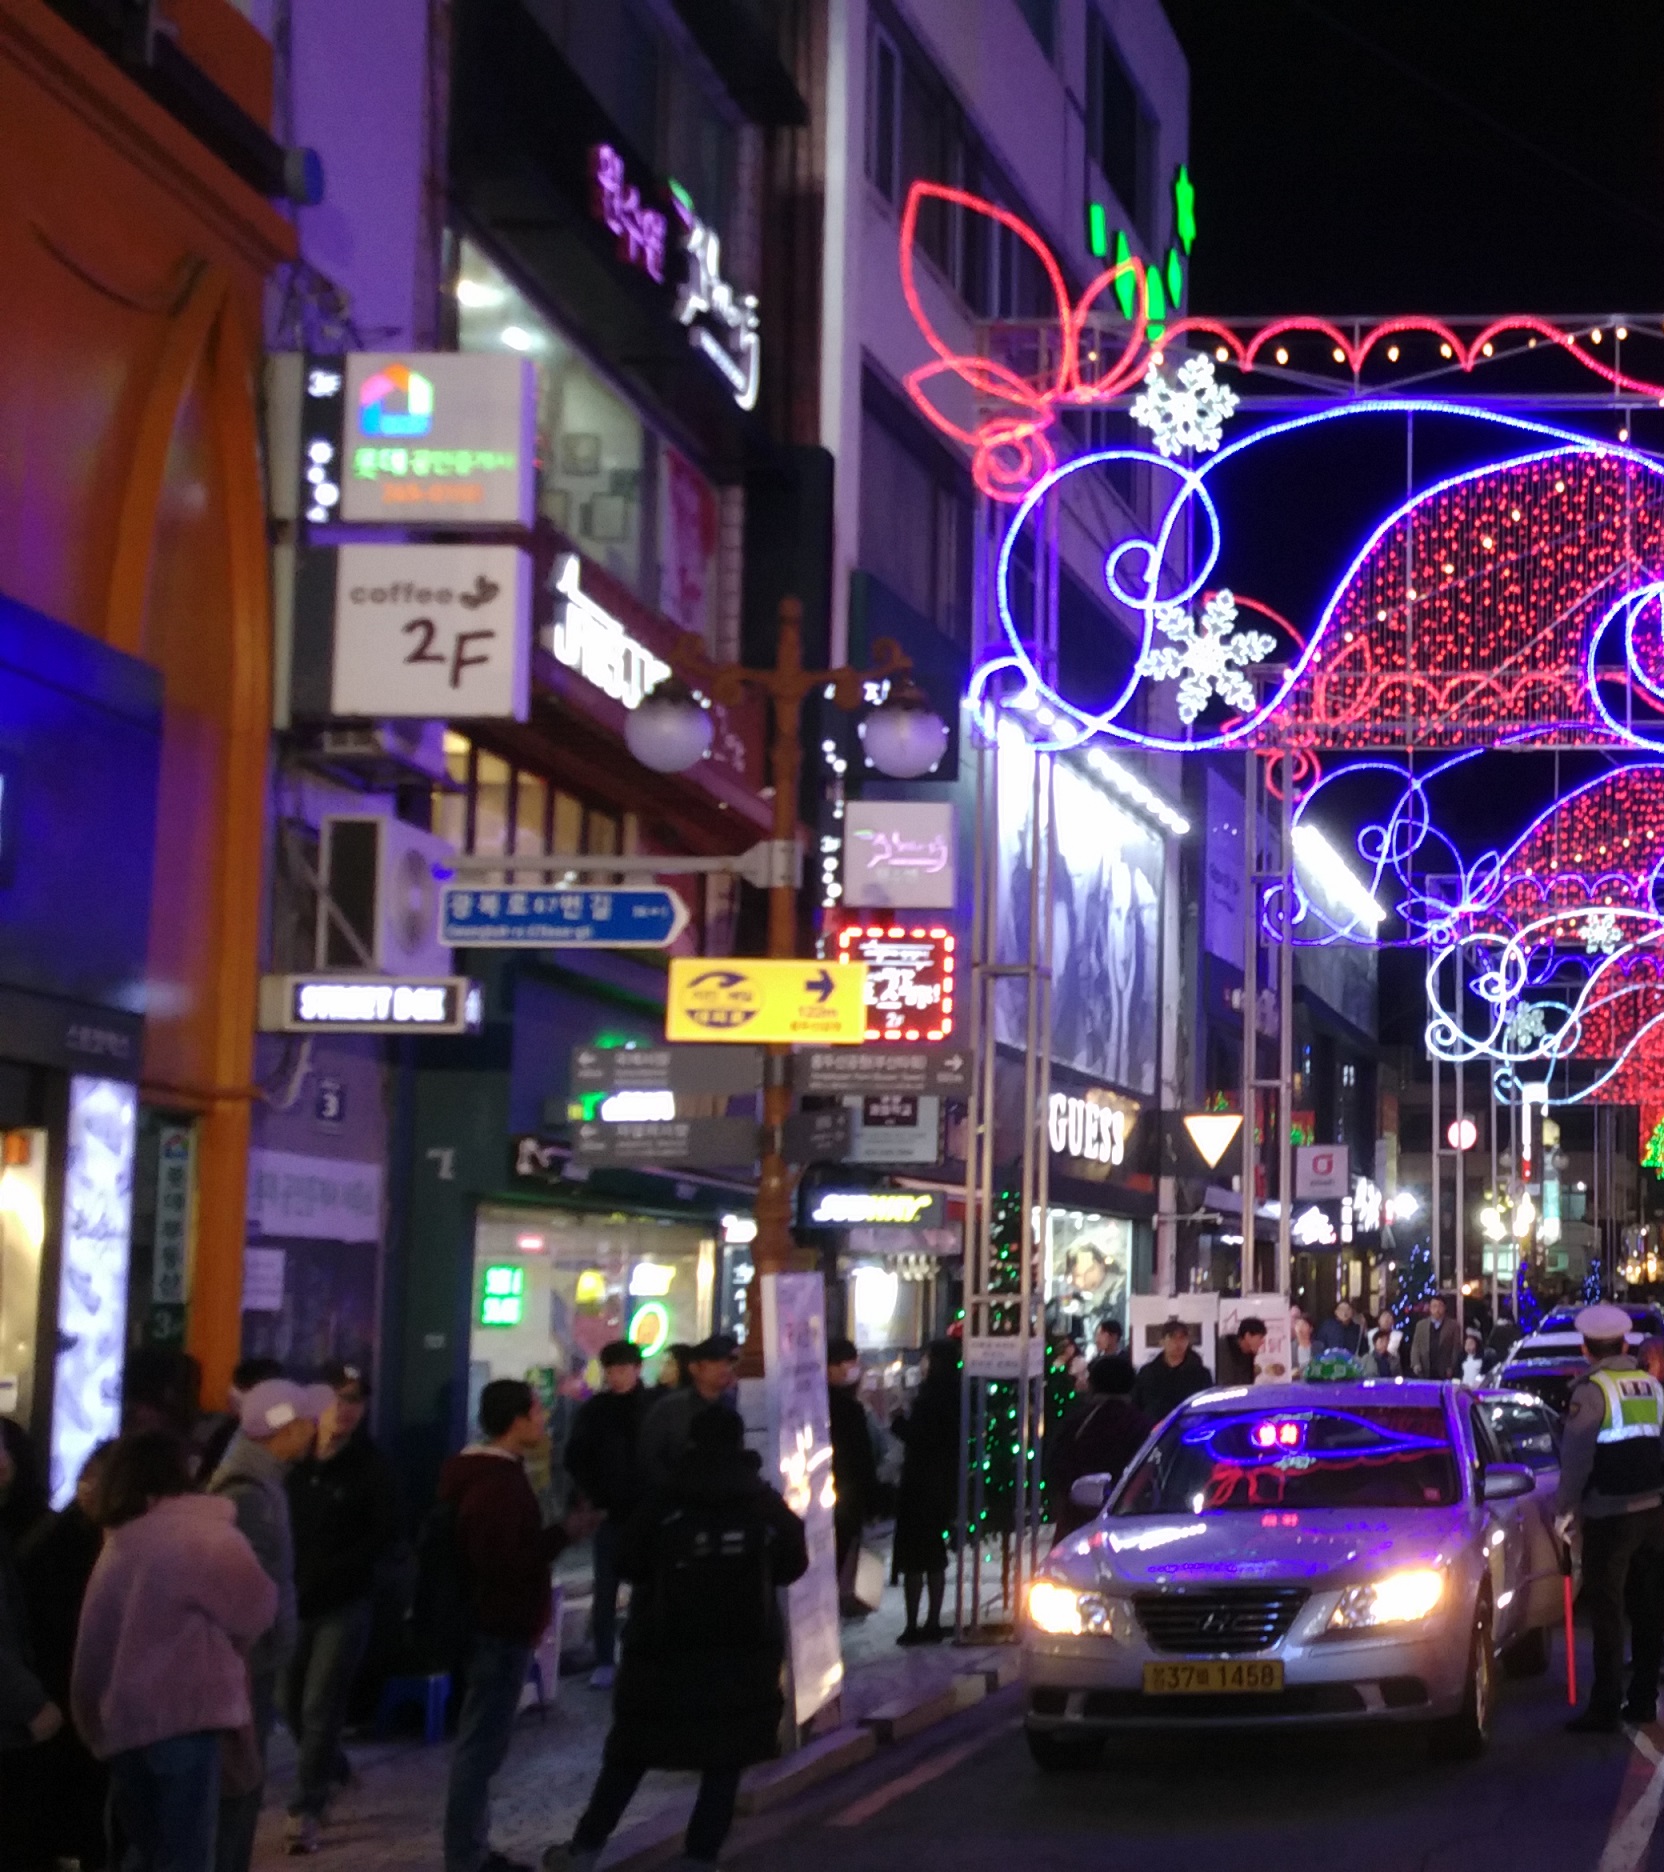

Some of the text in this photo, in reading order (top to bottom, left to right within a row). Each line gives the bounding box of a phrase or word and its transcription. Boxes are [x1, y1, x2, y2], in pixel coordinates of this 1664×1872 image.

[350, 580, 454, 606] coffee
[403, 618, 495, 689] 2F
[1049, 1093, 1125, 1166] GUESS
[1217, 1663, 1274, 1688] 1458
